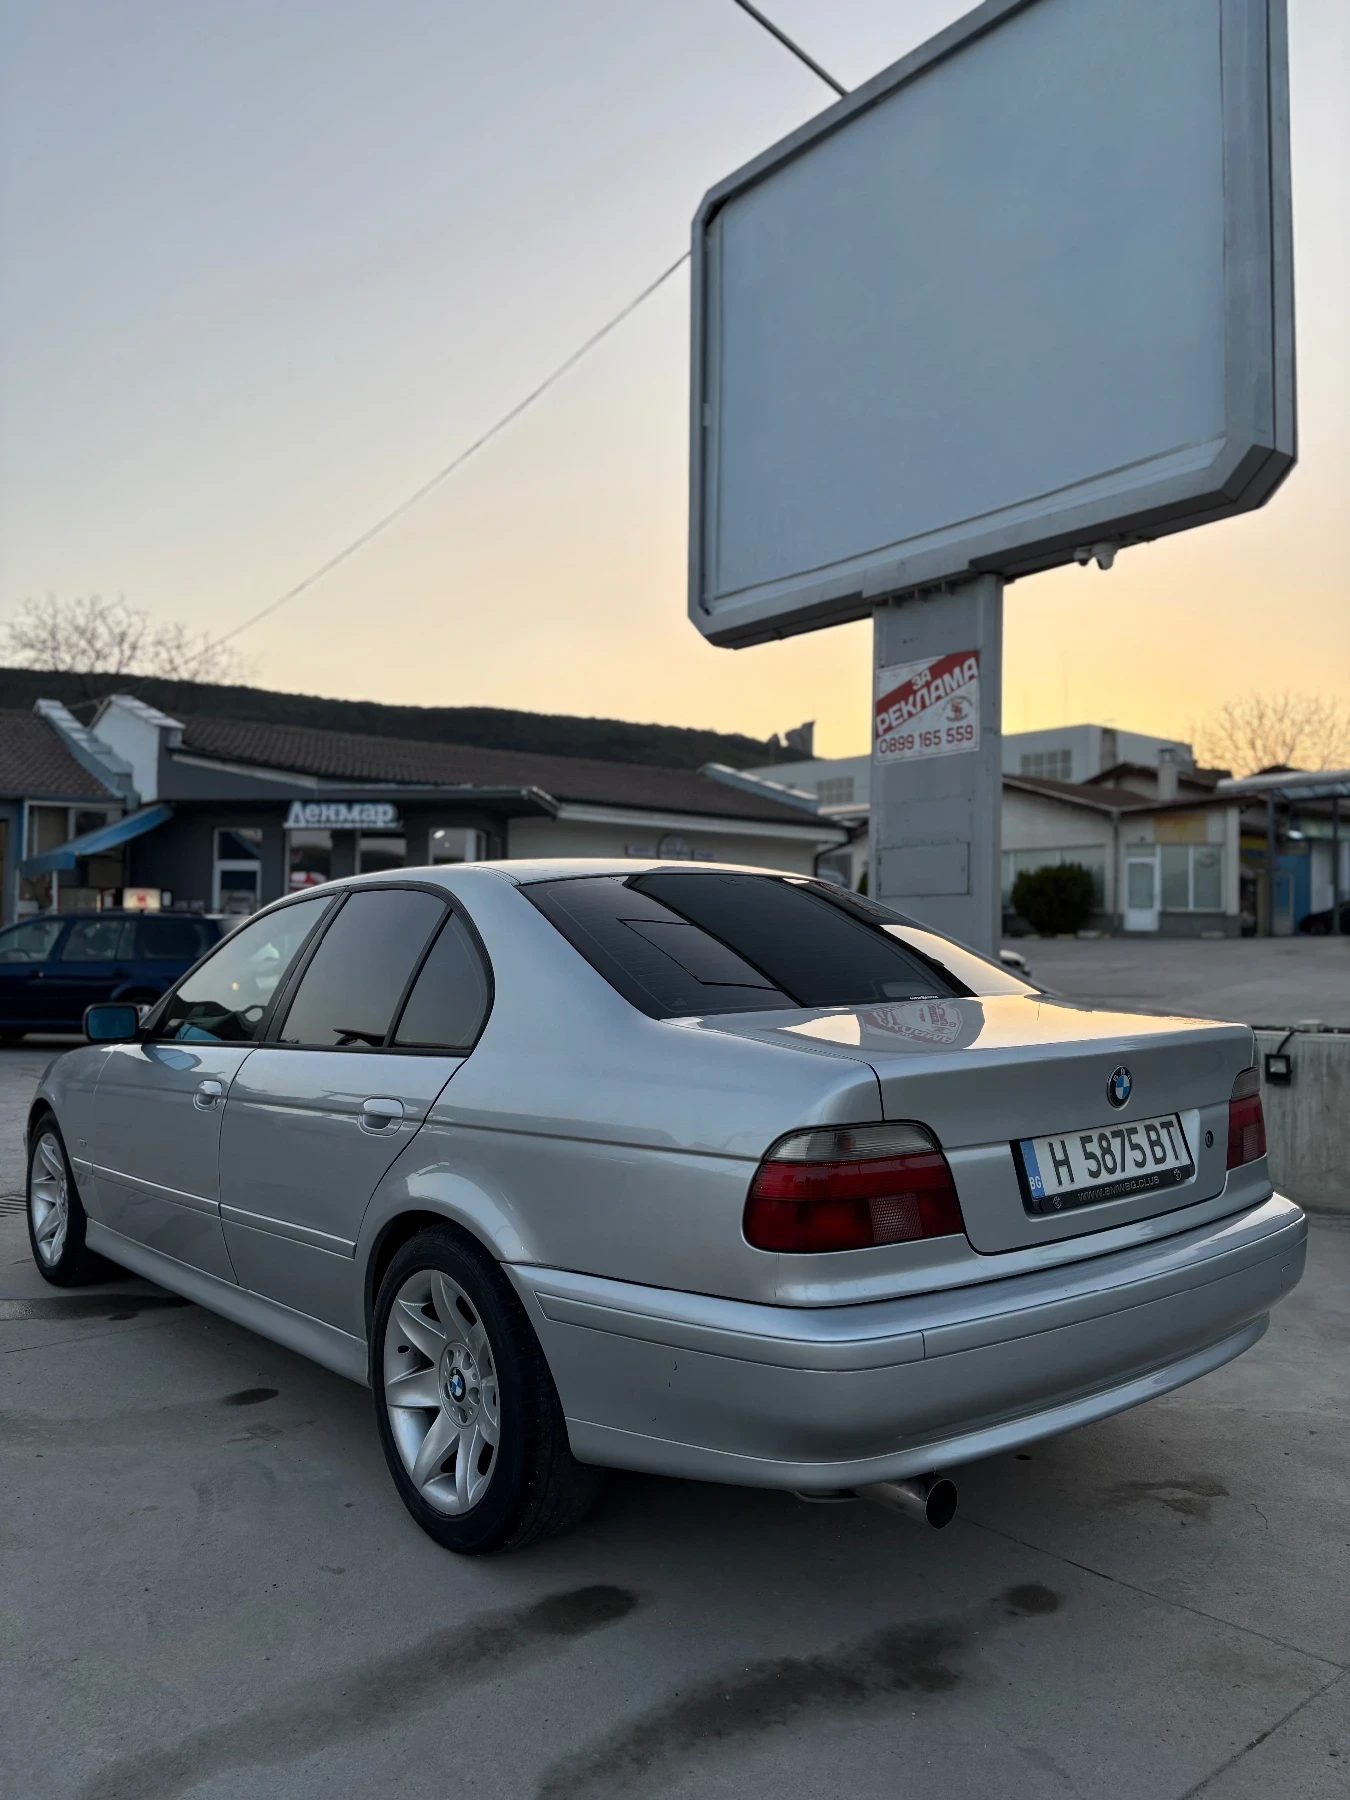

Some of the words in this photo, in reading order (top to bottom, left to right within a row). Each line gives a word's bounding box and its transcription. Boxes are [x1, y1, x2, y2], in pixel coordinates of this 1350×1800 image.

[911, 669, 931, 690] ЗА
[876, 657, 978, 735] РЕКЛАМА
[880, 734, 914, 754] 0899
[919, 729, 941, 748] 165
[946, 724, 973, 743] 559
[1048, 1139, 1075, 1186] H
[1029, 1176, 1042, 1190] BG
[1078, 1176, 1160, 1201] WWW.BMWBG.CLUB
